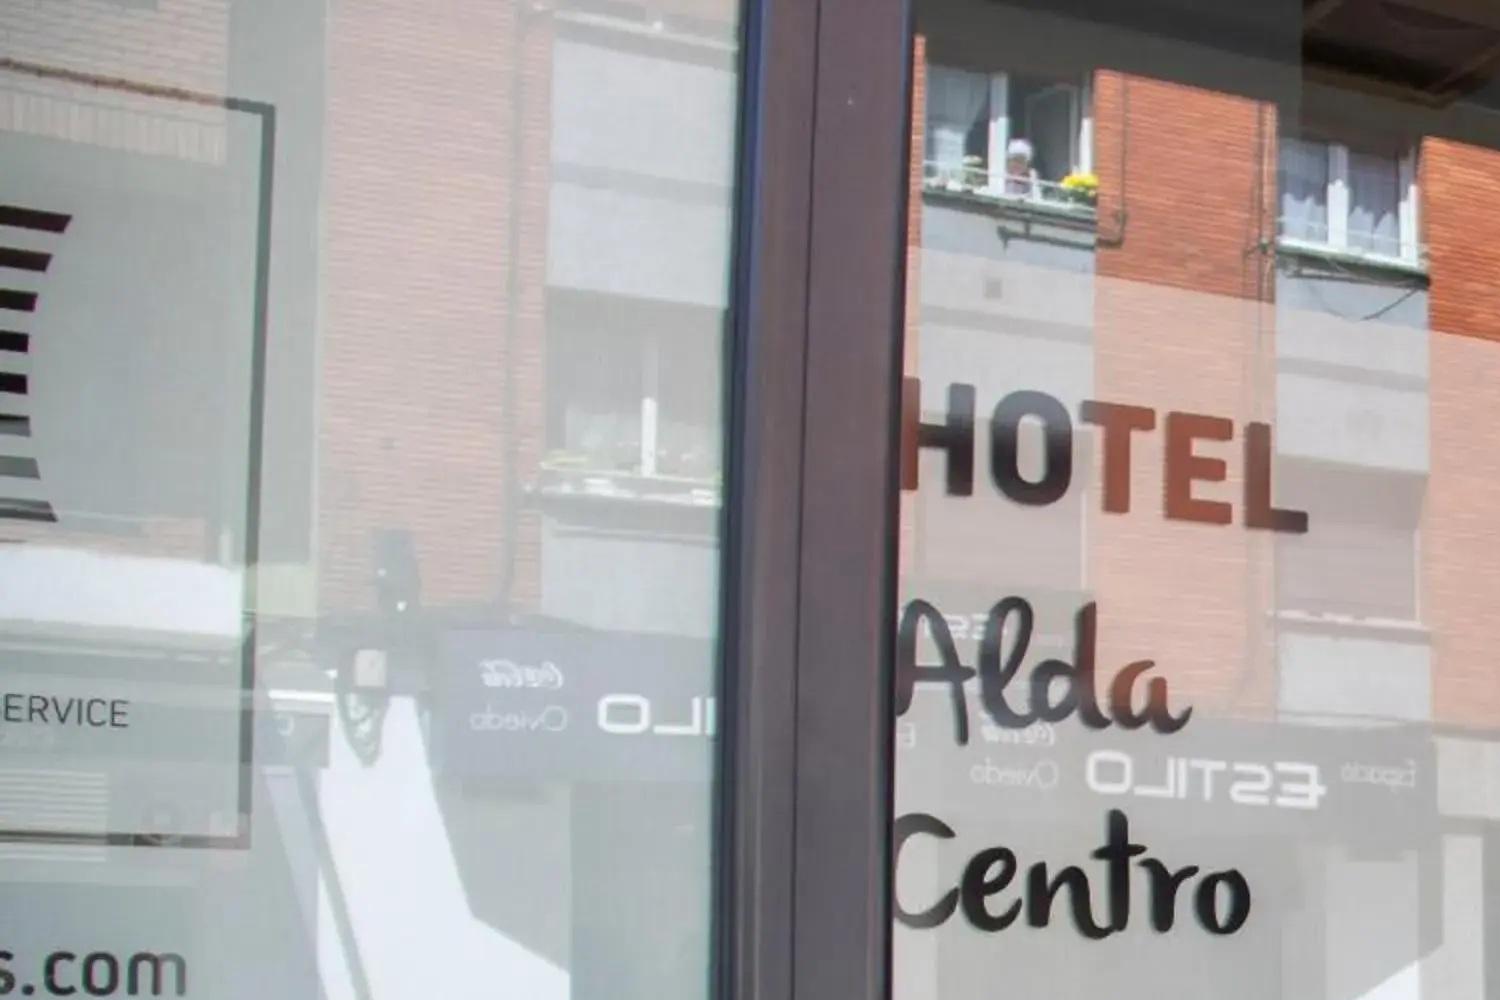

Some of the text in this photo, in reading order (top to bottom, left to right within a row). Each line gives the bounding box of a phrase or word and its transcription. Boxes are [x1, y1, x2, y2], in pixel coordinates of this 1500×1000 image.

[898, 376, 1309, 534] HOTEL
[0, 693, 130, 728] ERVICE
[894, 596, 1193, 746] Alda
[891, 809, 1251, 939] Centro
